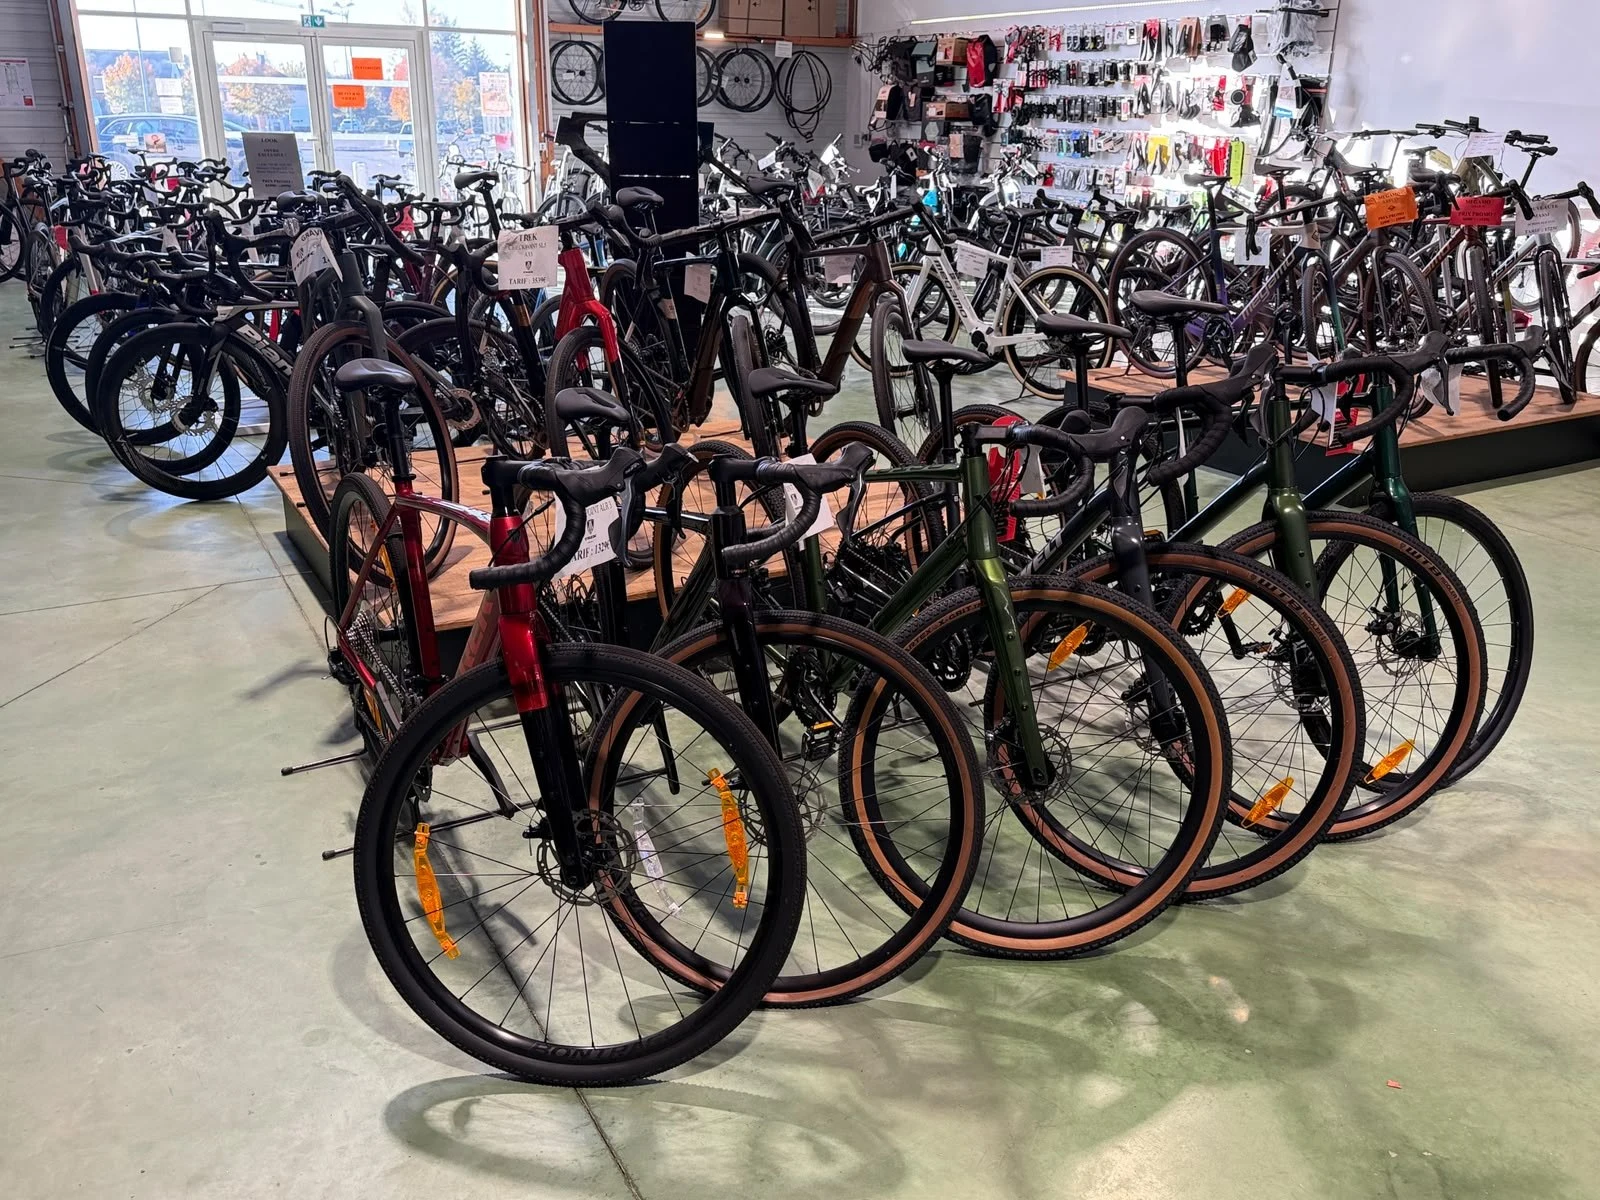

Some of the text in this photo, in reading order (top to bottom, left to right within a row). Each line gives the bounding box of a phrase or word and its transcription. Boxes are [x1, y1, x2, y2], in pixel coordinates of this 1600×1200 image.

[300, 229, 323, 242] GRAV
[519, 233, 537, 242] TREK
[235, 323, 294, 377] Bian
[572, 548, 590, 562] ARIF
